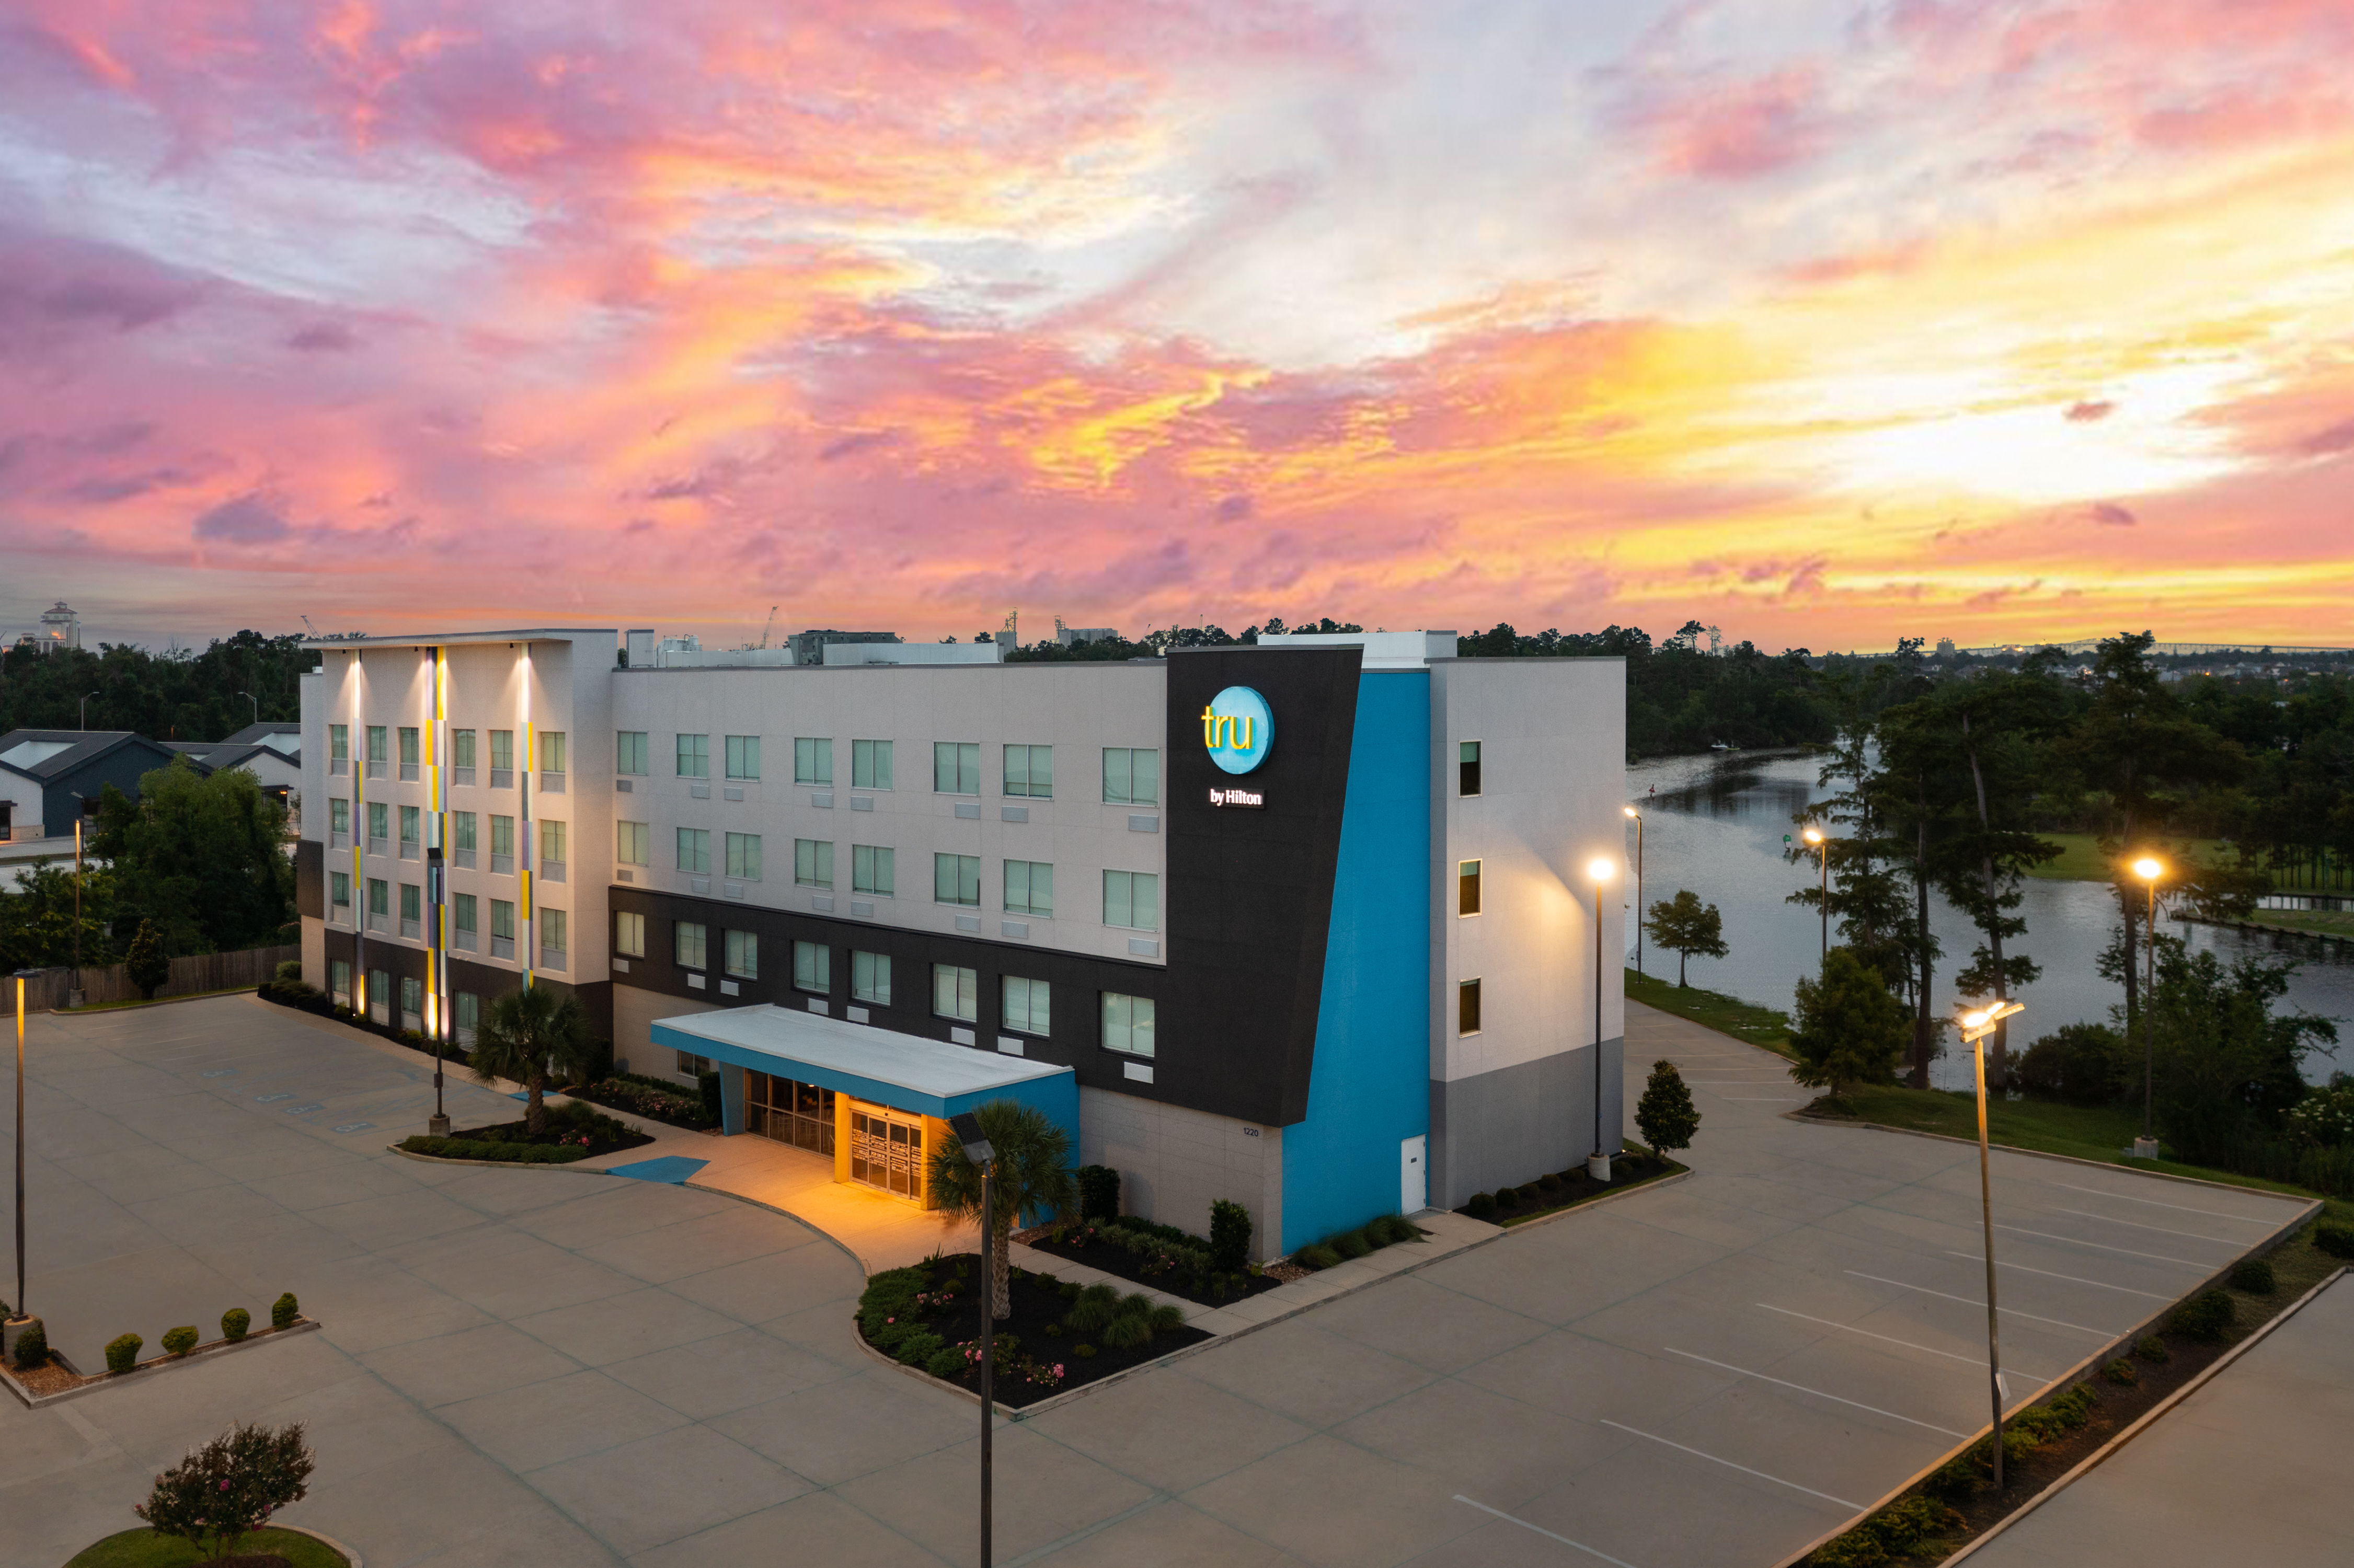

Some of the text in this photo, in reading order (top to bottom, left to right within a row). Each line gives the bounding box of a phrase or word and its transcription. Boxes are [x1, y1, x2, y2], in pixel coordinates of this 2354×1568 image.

[1201, 706, 1253, 750] tru
[1211, 789, 1262, 806] by Hilton
[1244, 1127, 1258, 1137] 1220
